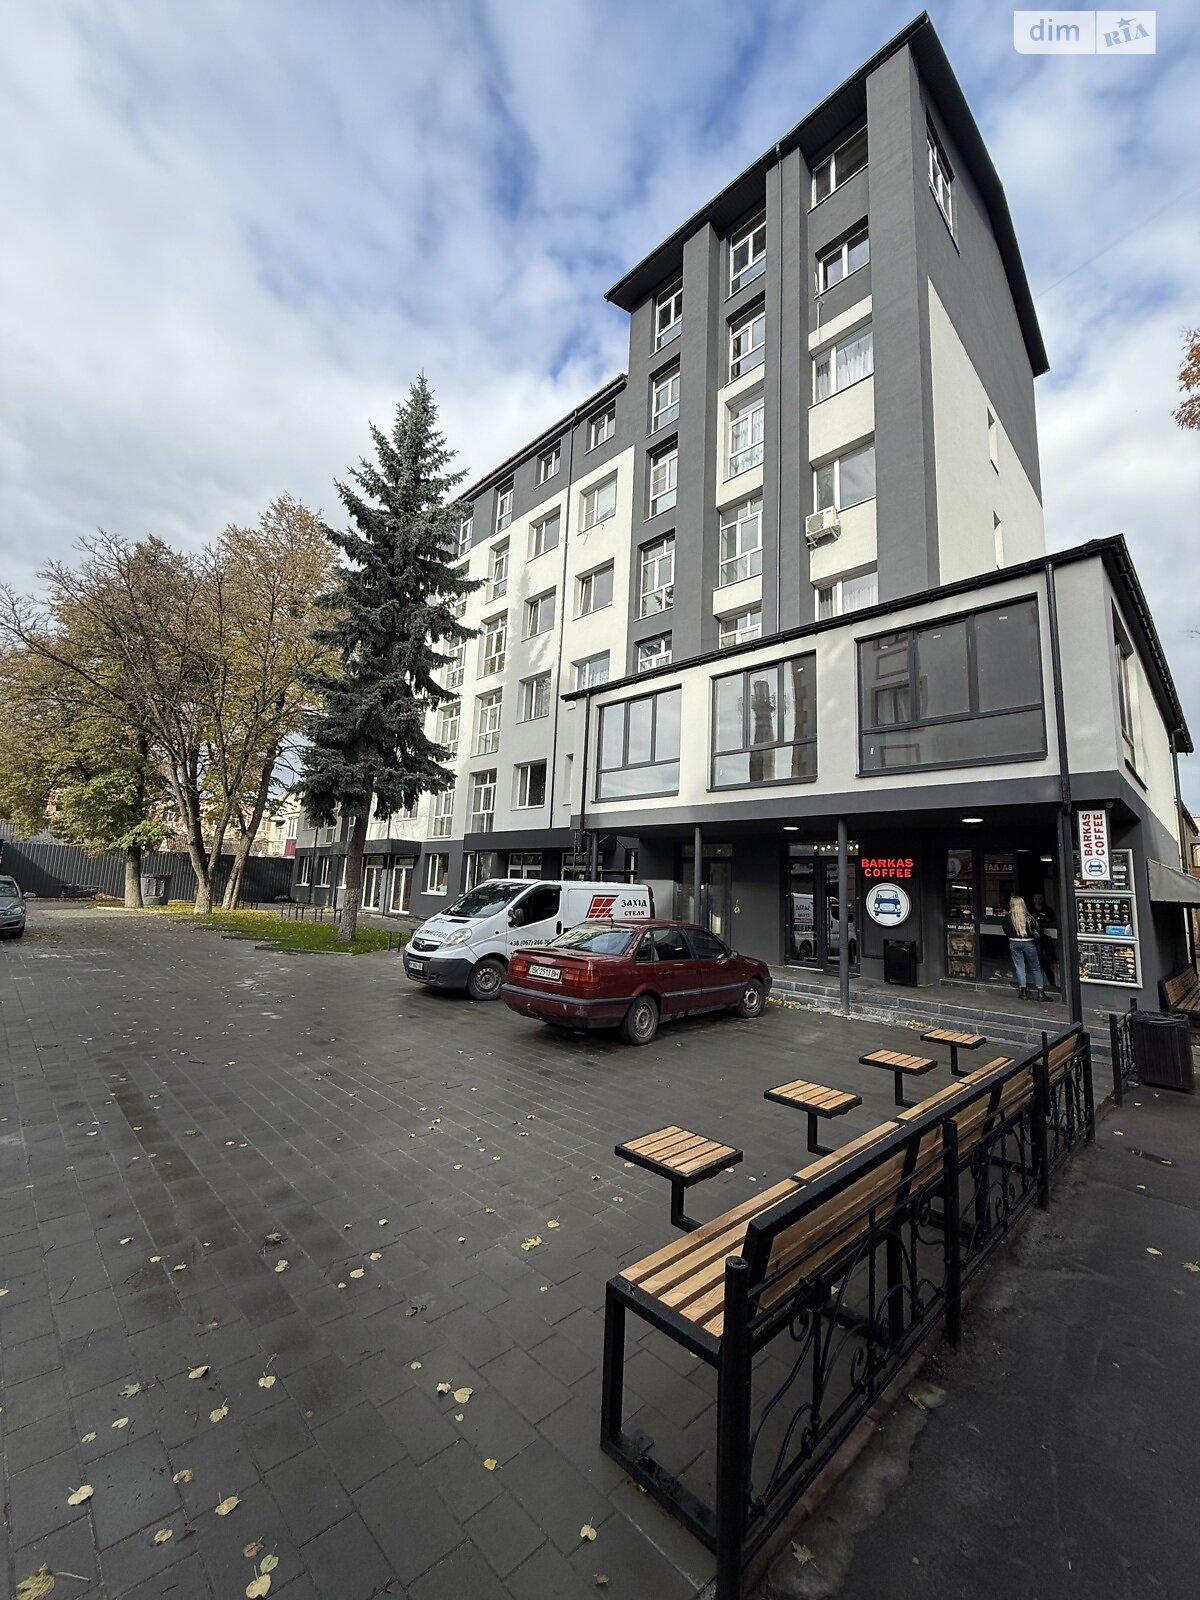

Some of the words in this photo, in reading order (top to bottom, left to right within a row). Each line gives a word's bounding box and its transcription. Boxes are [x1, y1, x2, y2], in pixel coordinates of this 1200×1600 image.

[1082, 813, 1093, 856] BARKAS
[1093, 813, 1105, 856] COFFEE
[861, 858, 914, 868] BARKAS
[864, 868, 912, 878] COFFEE
[621, 899, 647, 908] ЗАХІД
